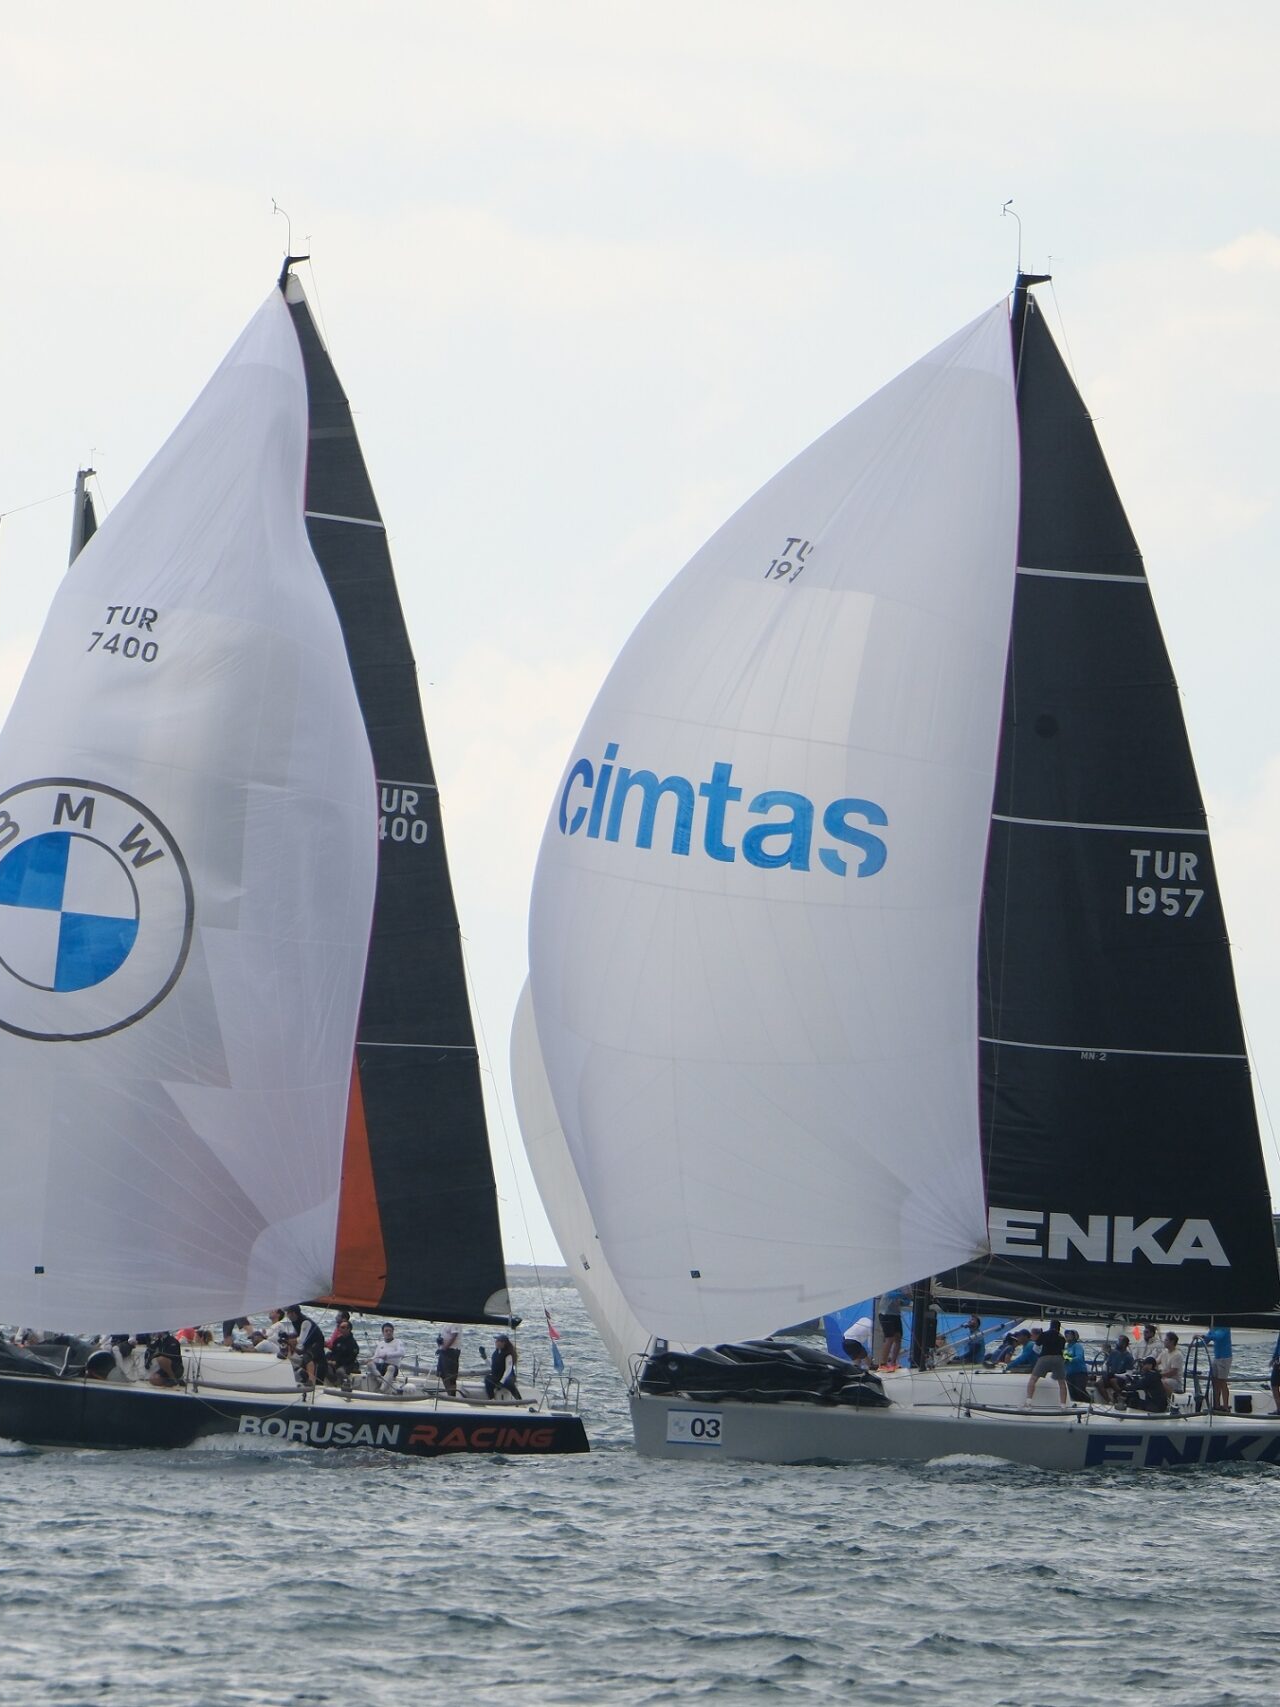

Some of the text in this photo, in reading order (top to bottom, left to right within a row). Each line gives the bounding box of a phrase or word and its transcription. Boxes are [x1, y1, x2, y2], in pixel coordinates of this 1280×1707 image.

[105, 605, 159, 632] TUR
[86, 631, 159, 662] 7400
[558, 742, 888, 878] cimtas
[1130, 849, 1198, 881] TUR
[1125, 886, 1205, 917] 1957
[989, 1207, 1232, 1267] ENKA
[238, 1414, 557, 1448] BORUSAN RACING
[690, 1418, 721, 1438] 03
